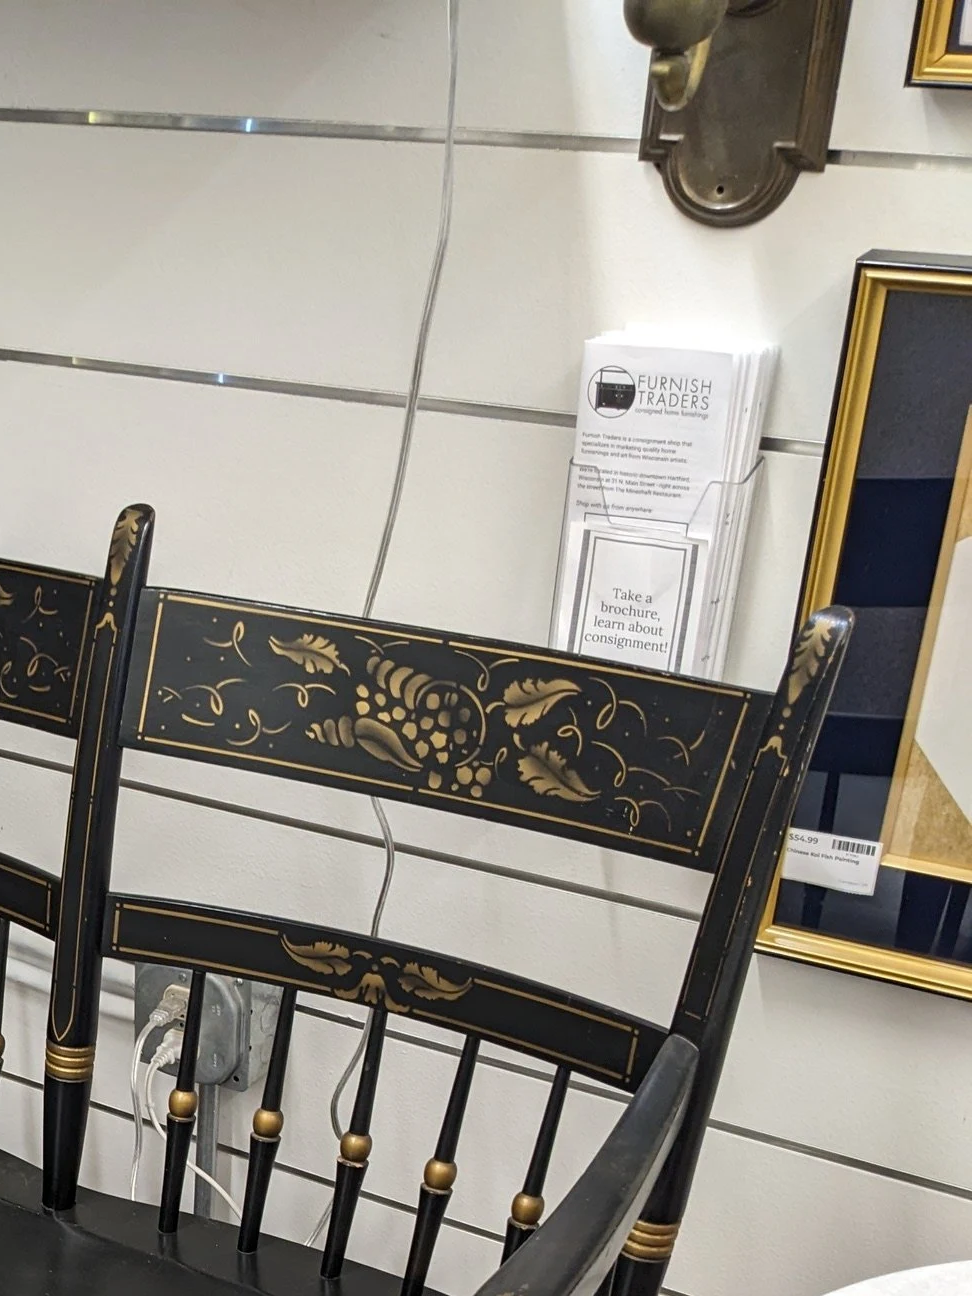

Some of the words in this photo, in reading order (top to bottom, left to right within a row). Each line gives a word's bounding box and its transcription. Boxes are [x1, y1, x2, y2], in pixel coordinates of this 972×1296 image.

[637, 375, 712, 395] FURNISH
[637, 390, 709, 411] TRADERS
[667, 439, 680, 447] shop
[576, 499, 589, 508] Shop
[613, 587, 642, 602] Take
[645, 596, 652, 604] a
[600, 600, 661, 622] brochure,
[593, 615, 626, 631] learn
[627, 621, 664, 637] about
[584, 632, 669, 654] consignment!
[821, 853, 834, 861] Fish
[834, 855, 860, 866] Painting
